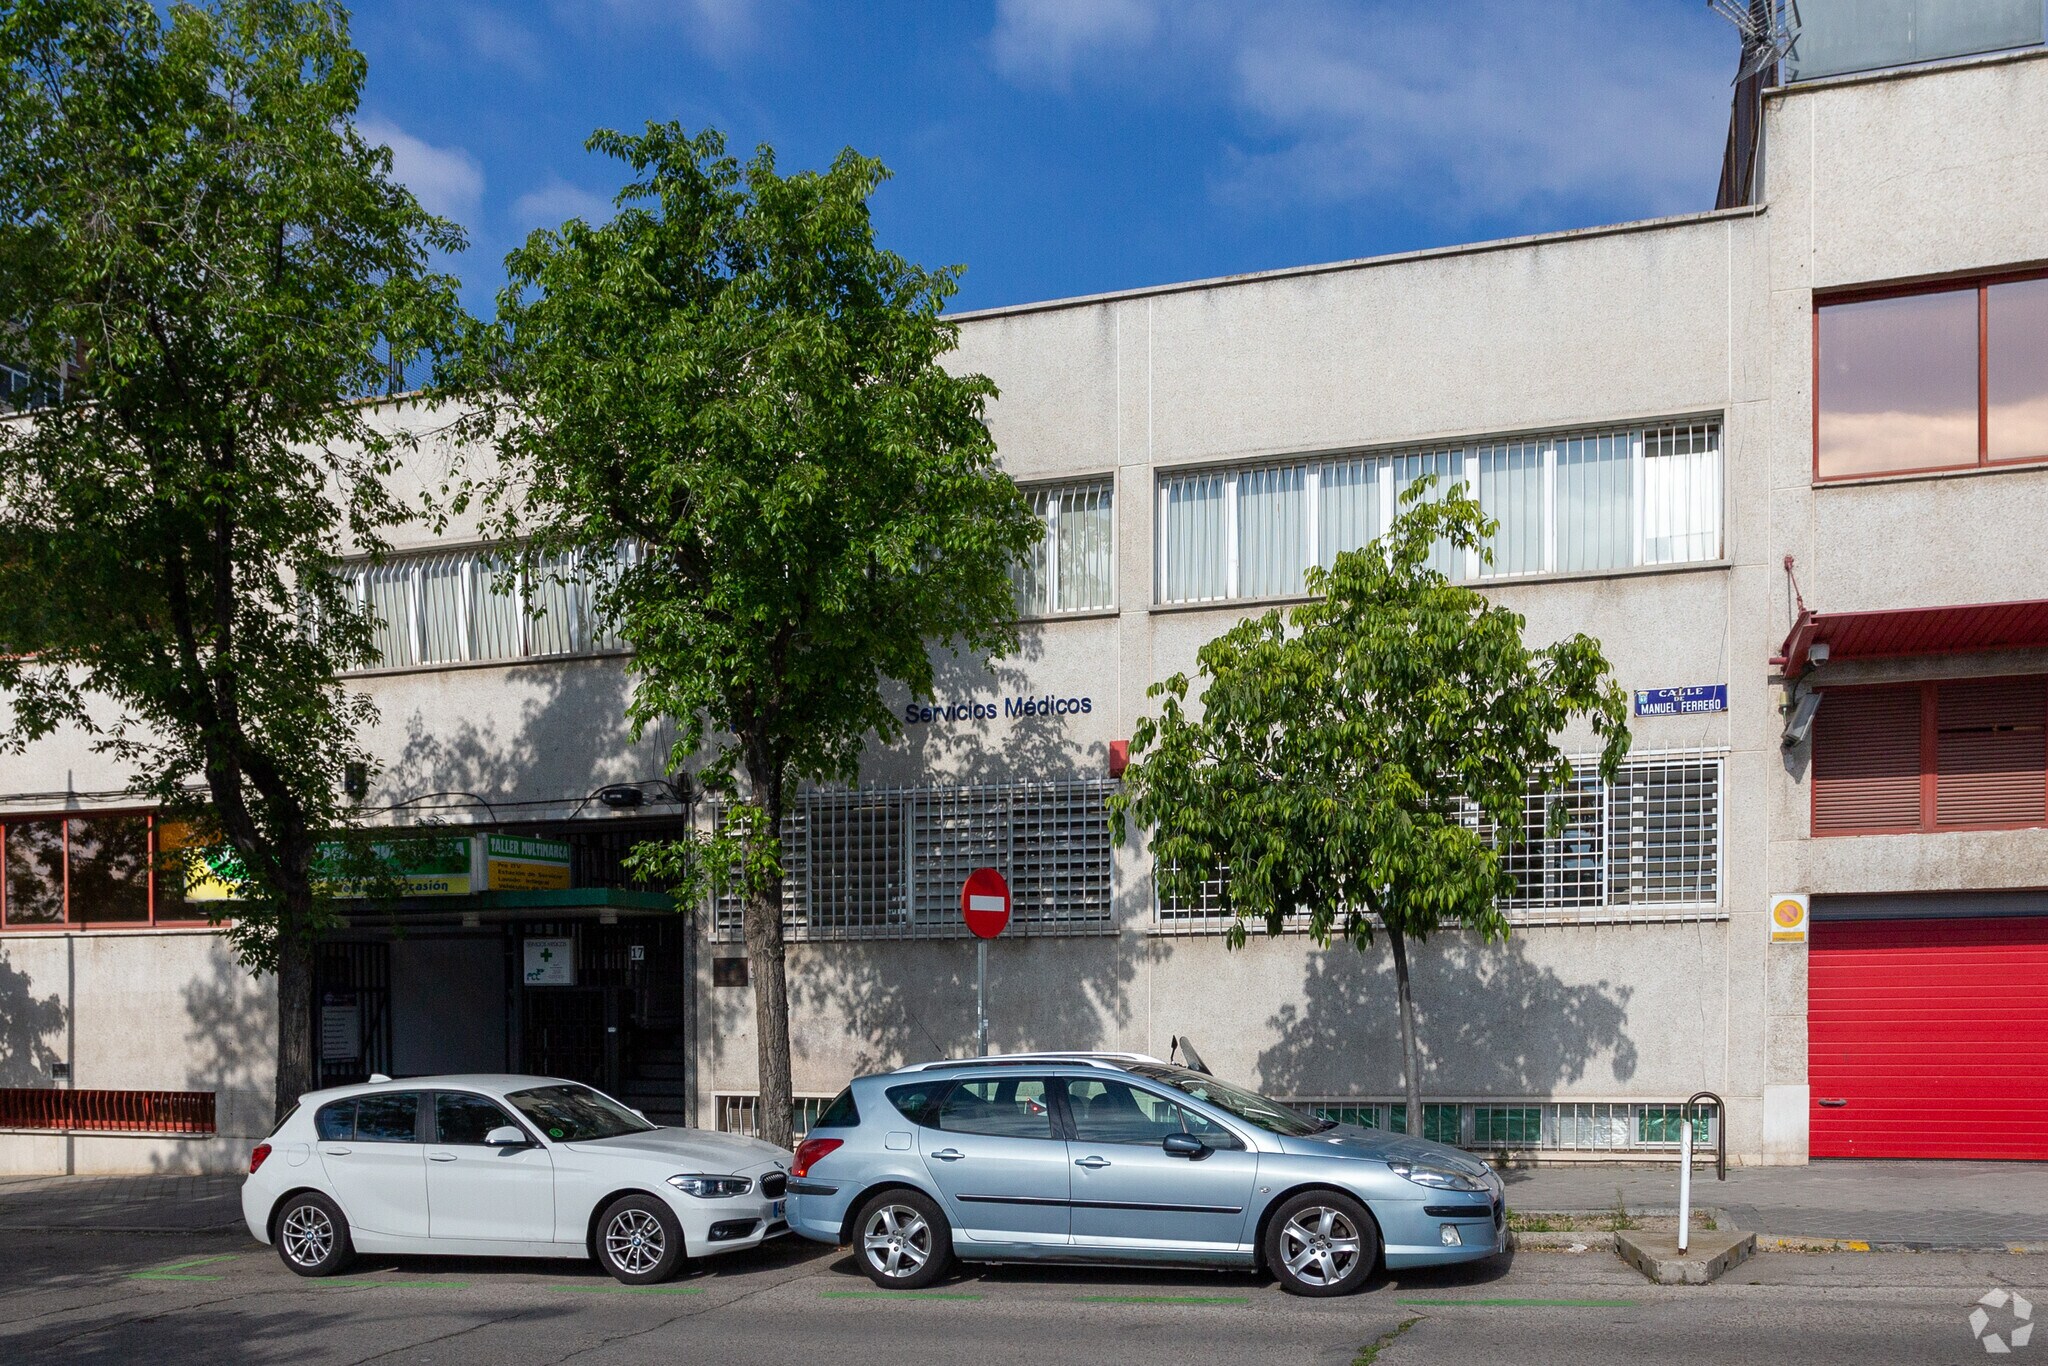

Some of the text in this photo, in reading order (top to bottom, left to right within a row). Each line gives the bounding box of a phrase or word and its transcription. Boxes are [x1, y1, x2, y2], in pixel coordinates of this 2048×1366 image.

[1658, 687, 1704, 697] CALLE
[905, 695, 1092, 723] Servicios Médicos
[1641, 699, 1721, 714] MANUEL FERRERO
[490, 837, 569, 860] TALLER MULTIMARCA
[632, 947, 643, 959] 17
